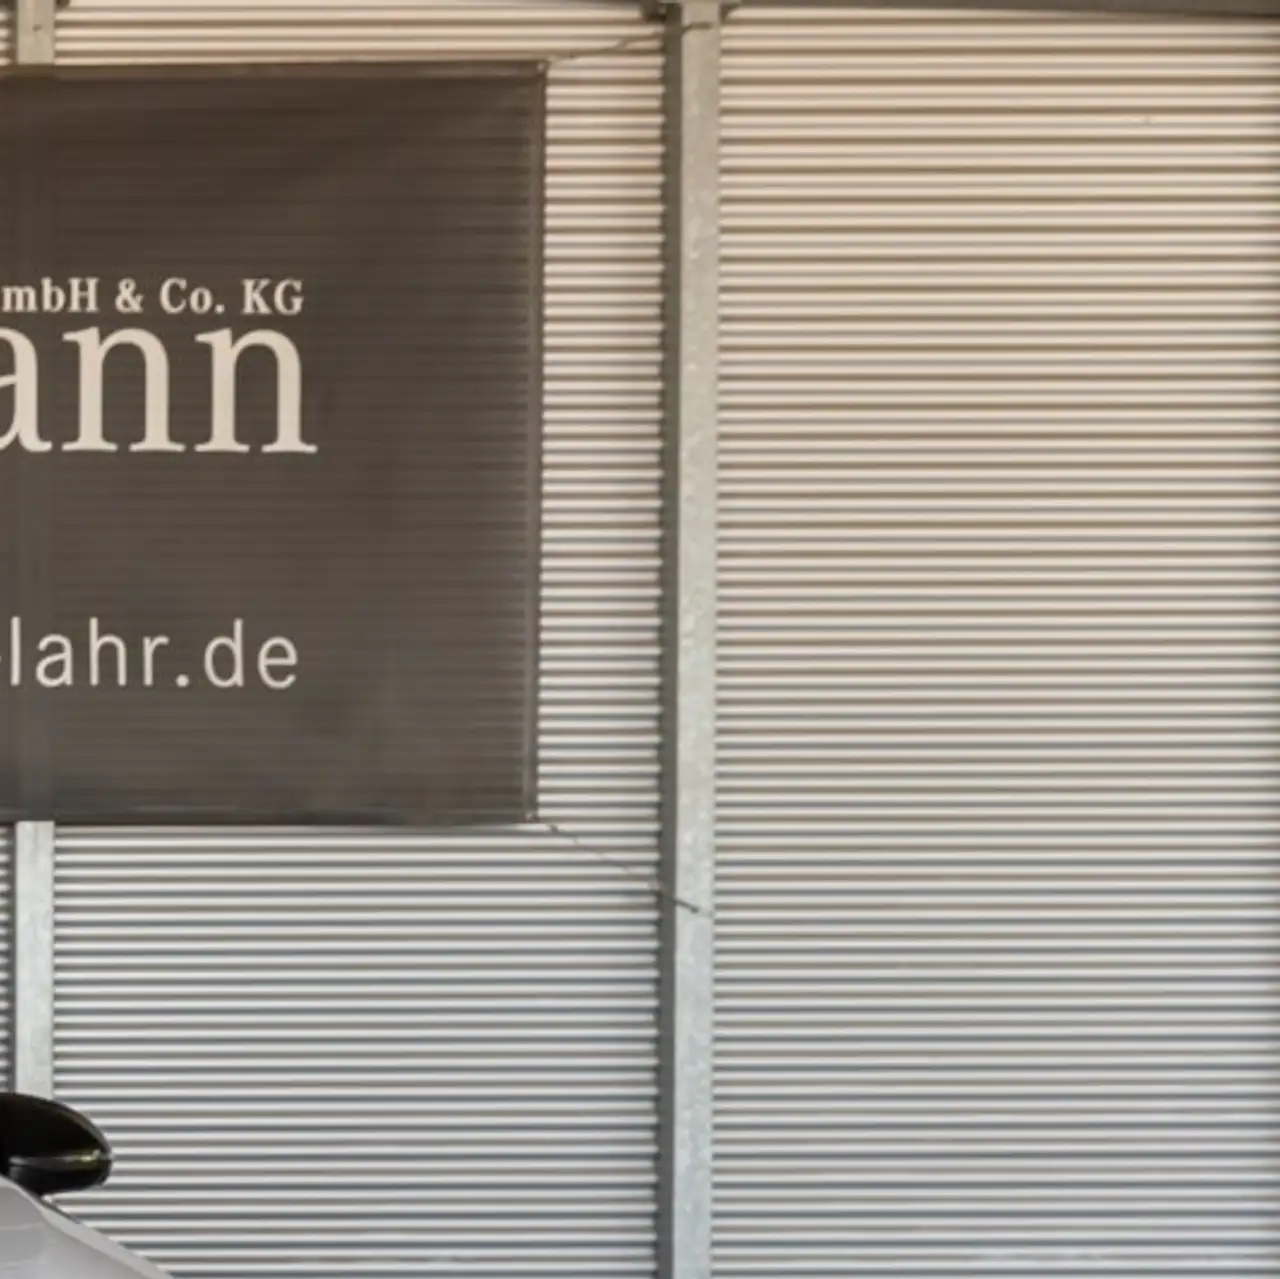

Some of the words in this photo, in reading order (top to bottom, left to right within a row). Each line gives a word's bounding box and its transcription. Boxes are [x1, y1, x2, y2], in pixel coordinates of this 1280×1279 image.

[115, 278, 143, 314] &
[159, 277, 225, 315] Co.
[242, 278, 304, 315] KG
